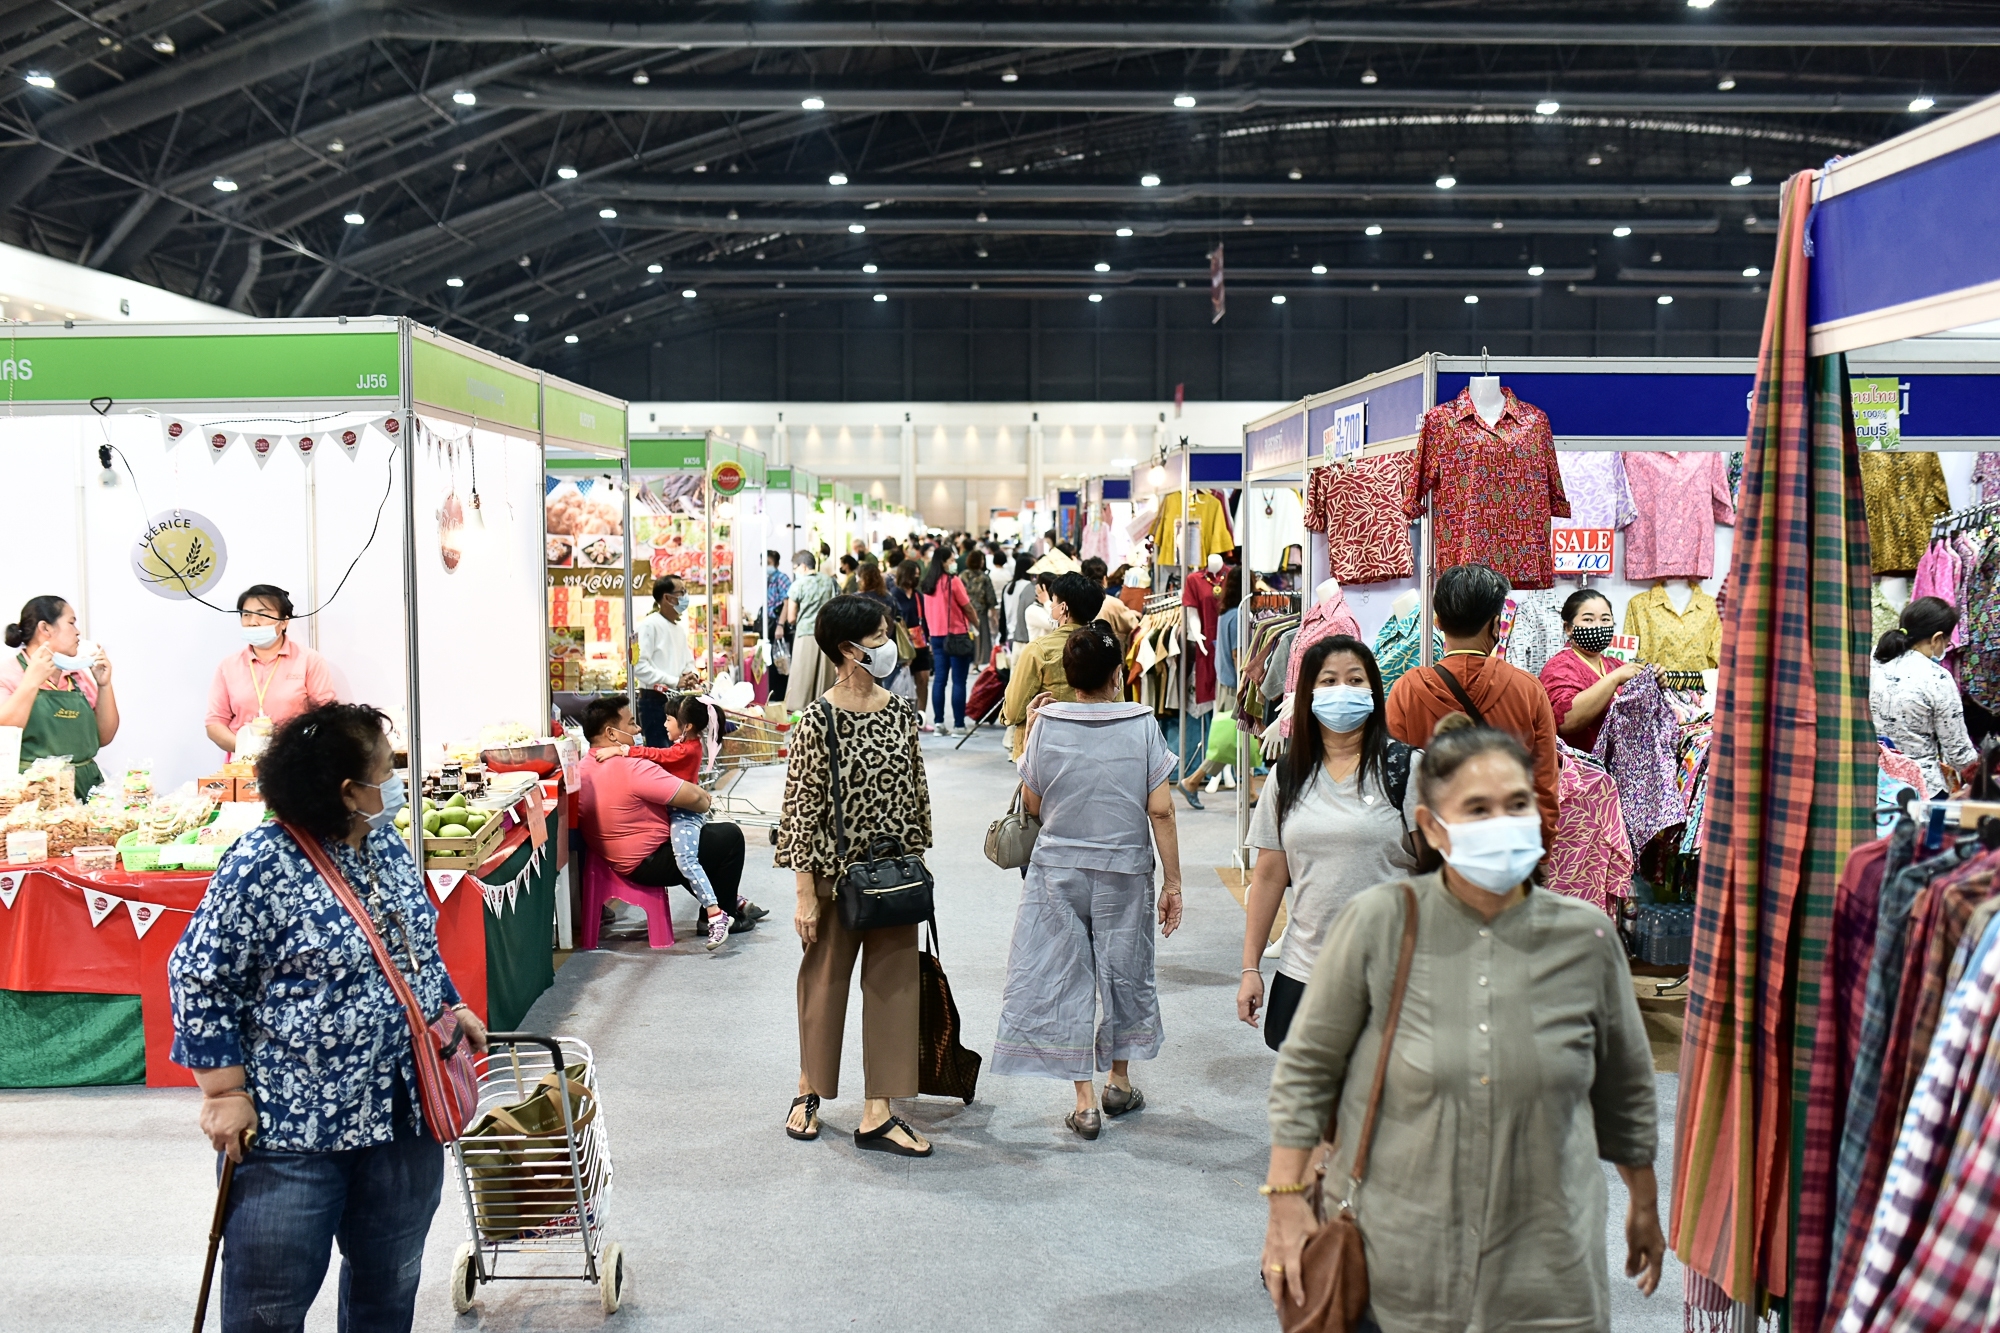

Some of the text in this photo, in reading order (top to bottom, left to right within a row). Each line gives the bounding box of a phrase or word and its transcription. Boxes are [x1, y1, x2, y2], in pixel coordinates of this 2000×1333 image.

[0, 358, 33, 381] คร
[356, 373, 388, 389] JJ56
[1851, 384, 1897, 404] ายไทย
[1862, 409, 1887, 419] 100%
[1344, 412, 1360, 450] 700
[1856, 422, 1887, 439] ณบุรี
[683, 456, 701, 466] KK56
[138, 518, 192, 549] LEERICE
[1555, 530, 1611, 552] SALE
[1554, 556, 1564, 568] 3
[1577, 553, 1609, 569] 700
[563, 573, 648, 593] หนองคย
[1609, 635, 1636, 650] ALE
